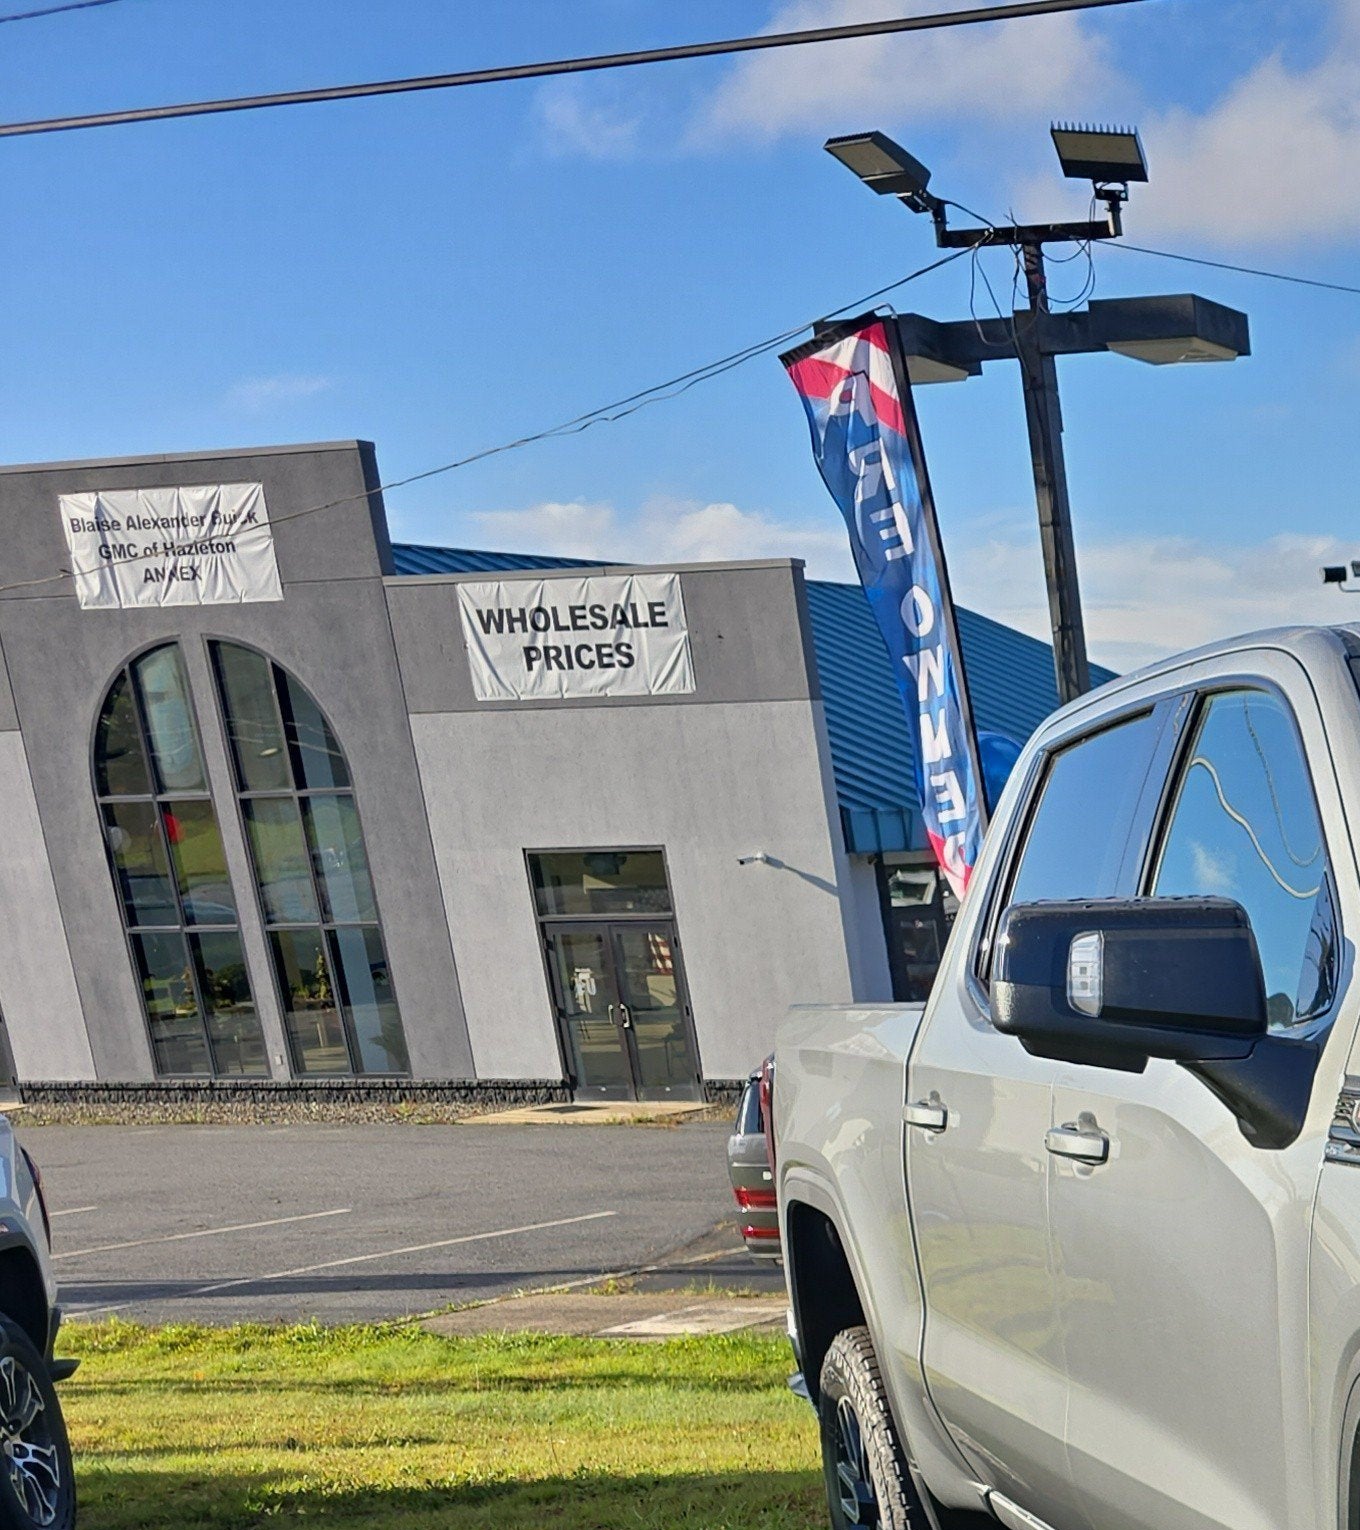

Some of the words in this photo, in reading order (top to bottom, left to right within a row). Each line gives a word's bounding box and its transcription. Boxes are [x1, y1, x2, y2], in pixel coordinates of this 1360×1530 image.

[70, 516, 121, 533] Blaise
[126, 512, 206, 531] Alexander
[98, 543, 139, 559] GMC
[143, 541, 159, 558] of
[163, 541, 236, 557] Hazleton
[143, 565, 202, 583] ANNEX
[476, 602, 669, 634] WHOLESALE
[523, 642, 635, 672] PRICES
